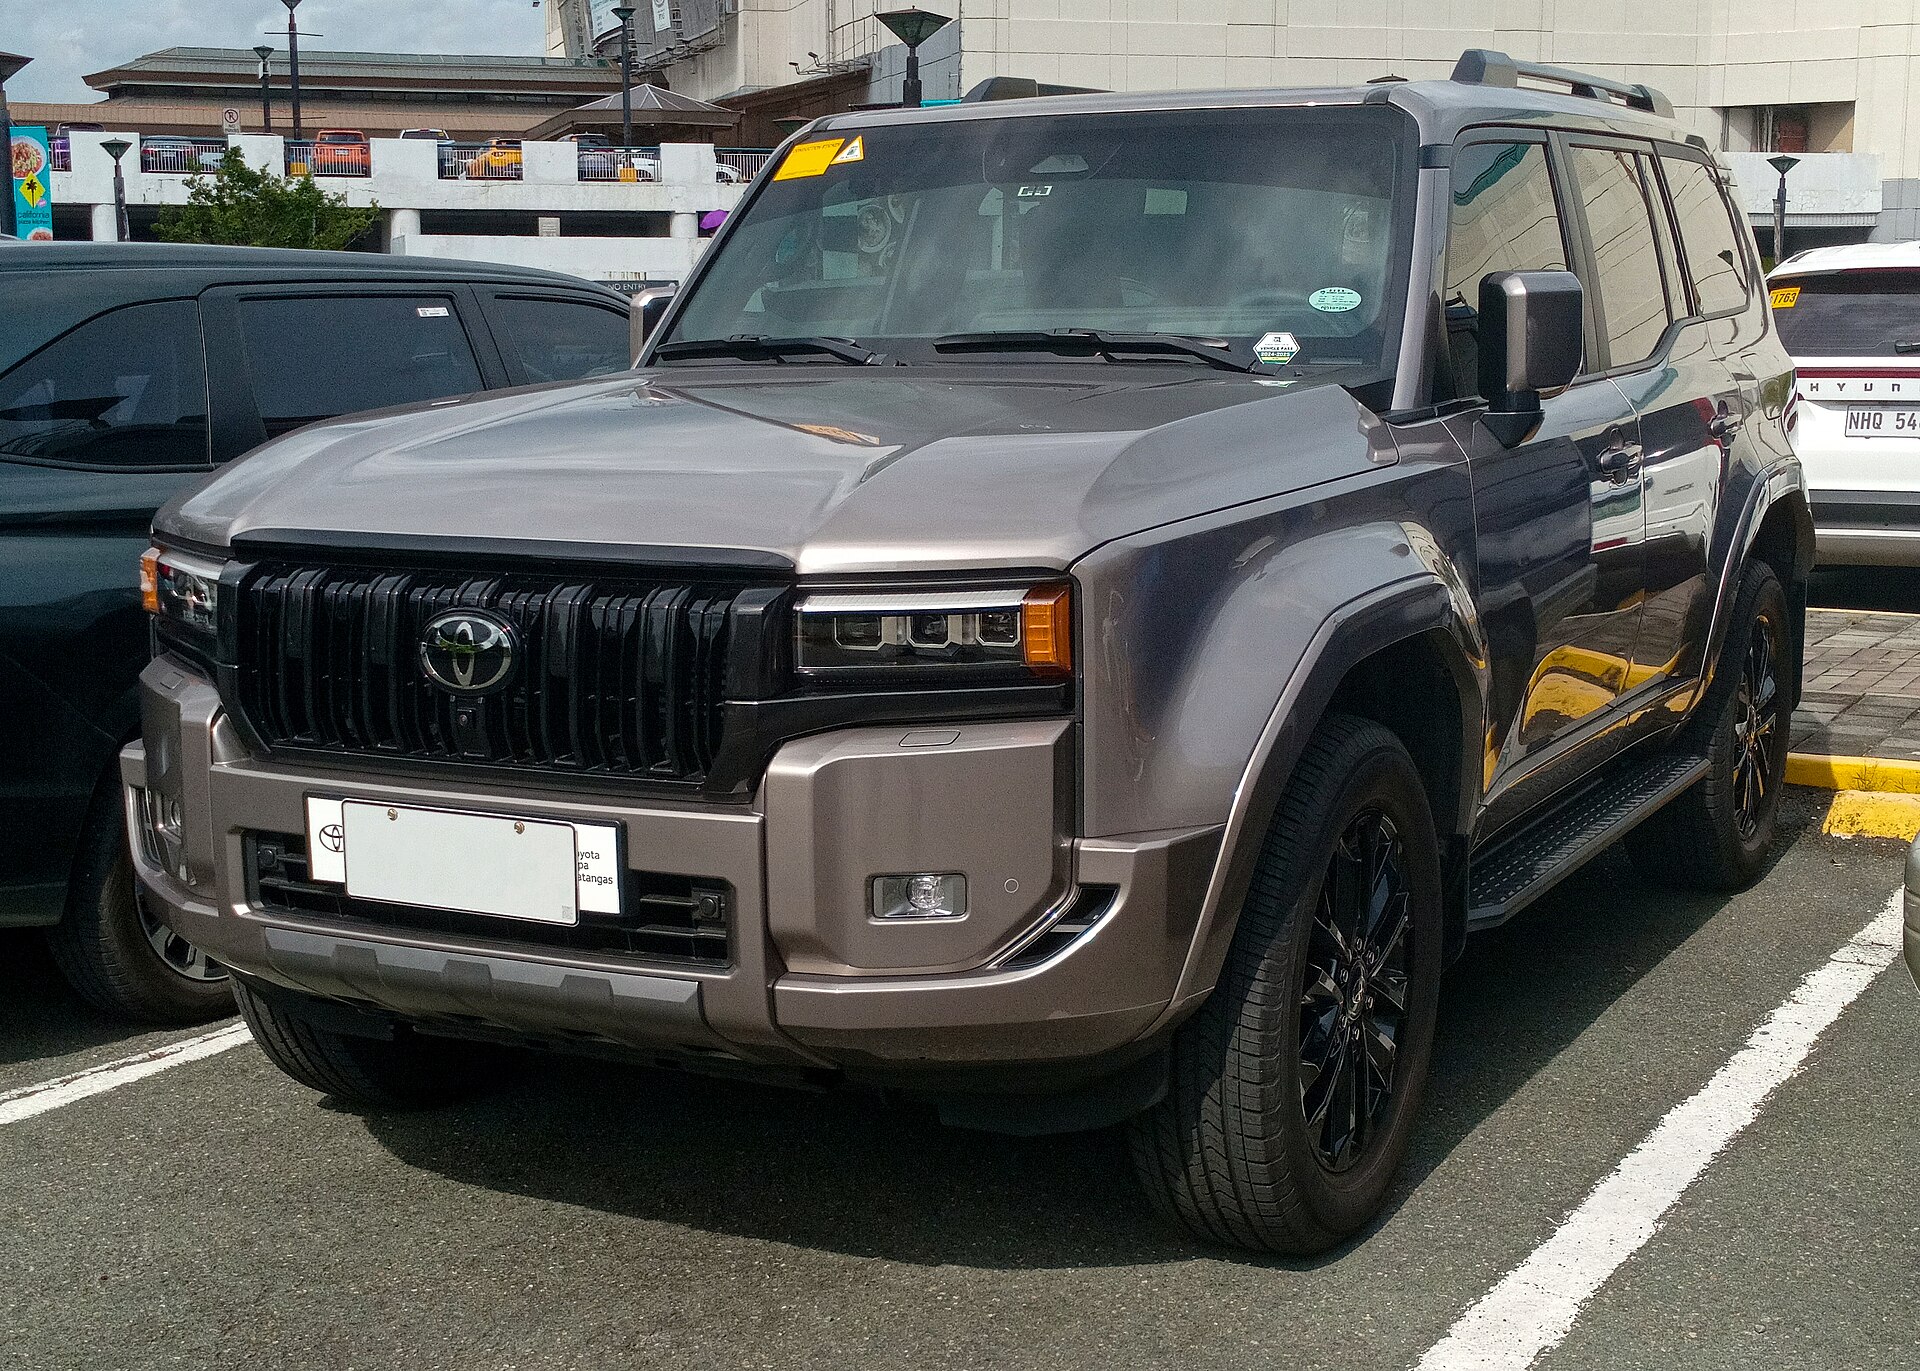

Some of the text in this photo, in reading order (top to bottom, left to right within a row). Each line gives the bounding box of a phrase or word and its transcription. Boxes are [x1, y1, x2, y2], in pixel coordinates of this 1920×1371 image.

[1810, 383, 1920, 392] HYUN
[1849, 412, 1920, 430] NHQ 54
[578, 851, 600, 860] yota
